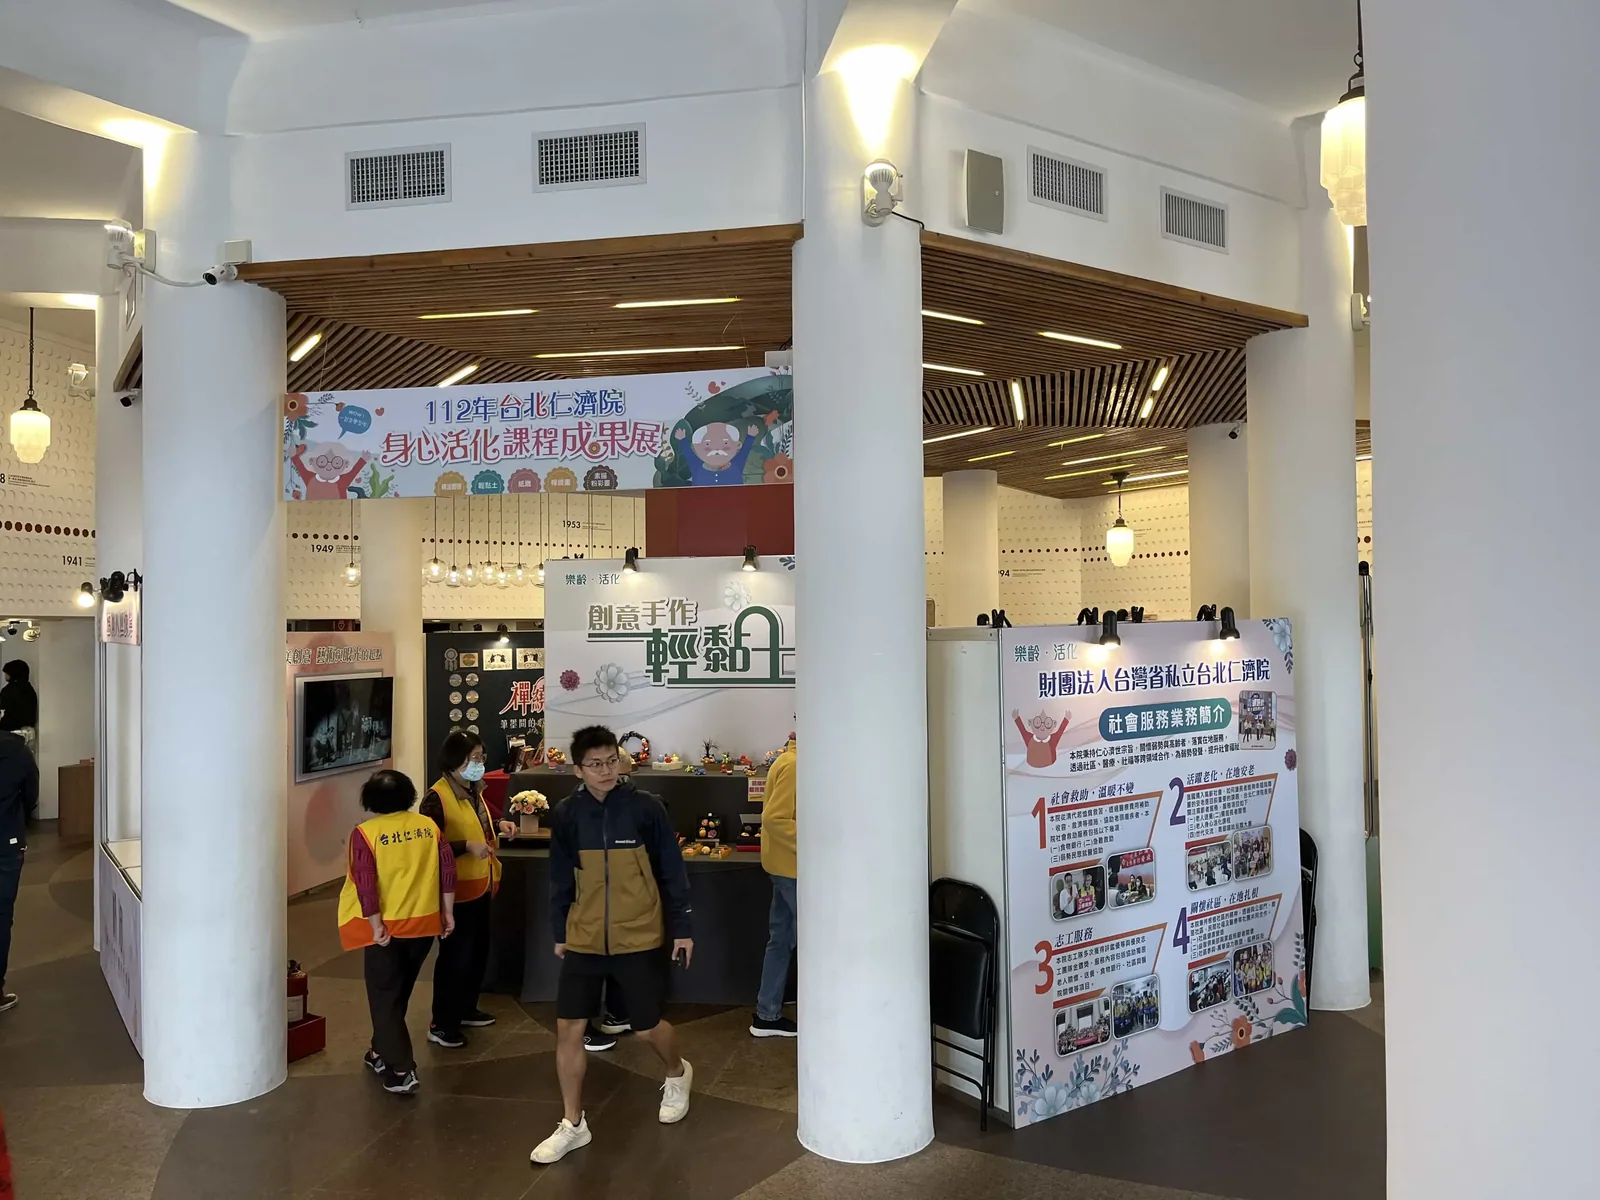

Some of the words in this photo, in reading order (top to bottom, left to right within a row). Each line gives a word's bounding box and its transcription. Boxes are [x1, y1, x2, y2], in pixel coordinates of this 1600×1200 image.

[424, 388, 626, 423] 112年台北仁濟院
[382, 420, 663, 466] 身心活化課程成果展
[562, 520, 581, 529] 1953
[62, 555, 82, 566] 1941
[310, 544, 334, 553] 1949
[588, 597, 697, 631] 創意手作
[1038, 658, 1271, 699] 財團法人台灣省私立台北仁濟院
[1108, 703, 1225, 735] 社會服務業務簡介
[1169, 777, 1186, 826] 2
[380, 827, 434, 846] 台北仁濟院
[1031, 797, 1047, 849] 1
[1054, 927, 1093, 948] 志工服務
[1173, 907, 1190, 954] 4
[1034, 940, 1054, 995] 3
